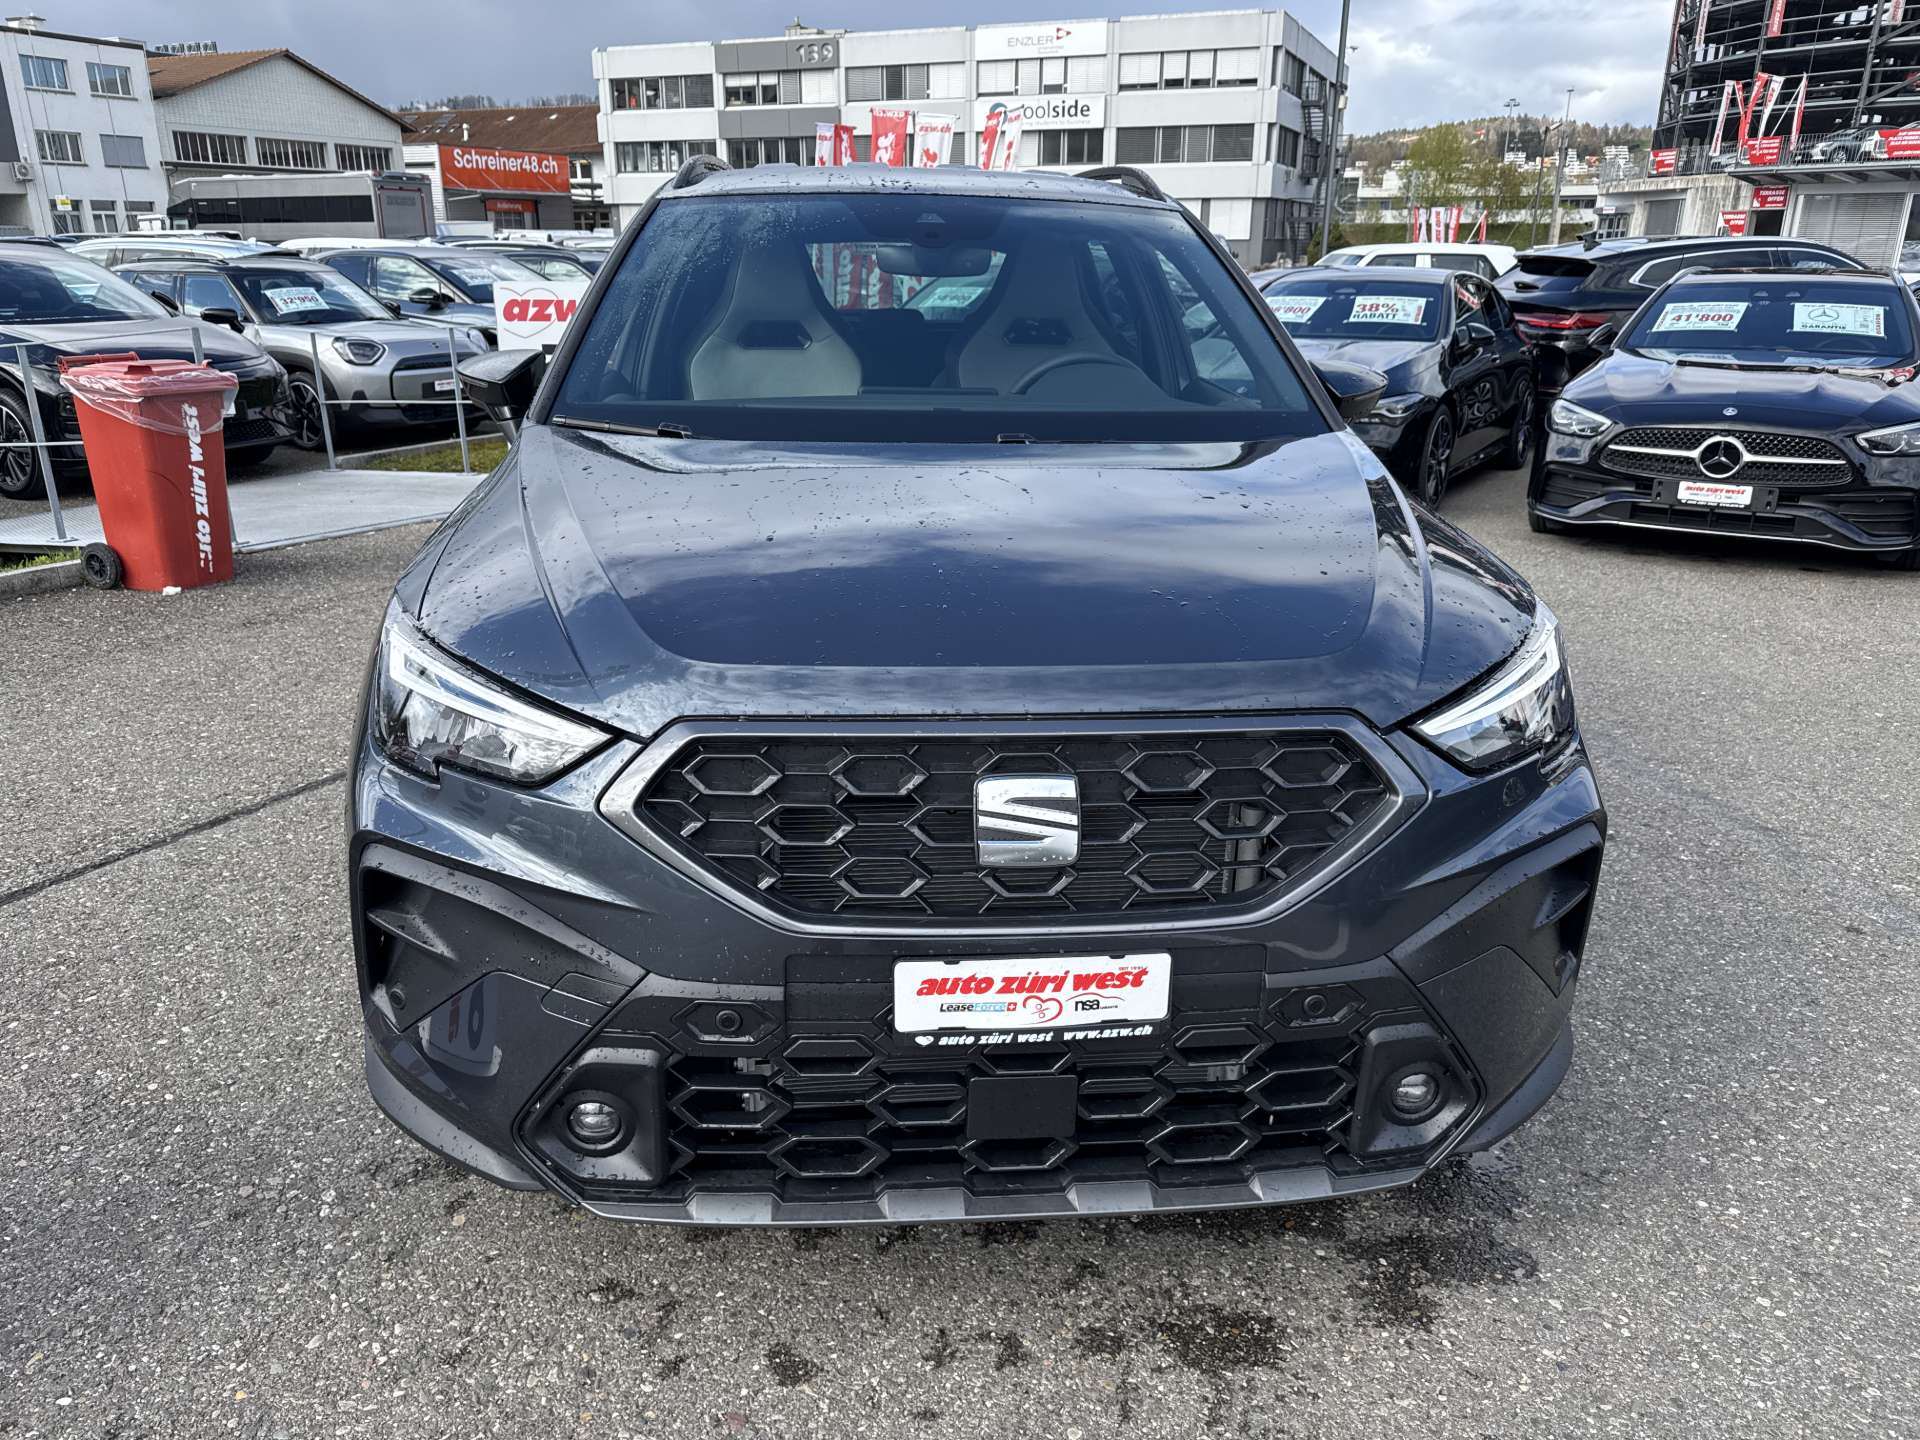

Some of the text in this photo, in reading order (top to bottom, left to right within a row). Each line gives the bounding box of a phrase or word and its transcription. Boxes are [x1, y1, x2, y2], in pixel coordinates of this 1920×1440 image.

[1007, 35, 1054, 47] ENZLER
[796, 43, 833, 63] 139
[1022, 99, 1090, 120] oolside
[453, 148, 558, 174] Schreiner48.ch
[1356, 303, 1399, 313] 38%
[1672, 313, 1734, 322] 41'800
[188, 465, 209, 518] züri
[916, 967, 1149, 996] auto züri west
[940, 1002, 1006, 1012] LeaseForce
[1074, 999, 1100, 1012] nsa
[938, 1024, 1153, 1045] auto züri west www.azw.ch
